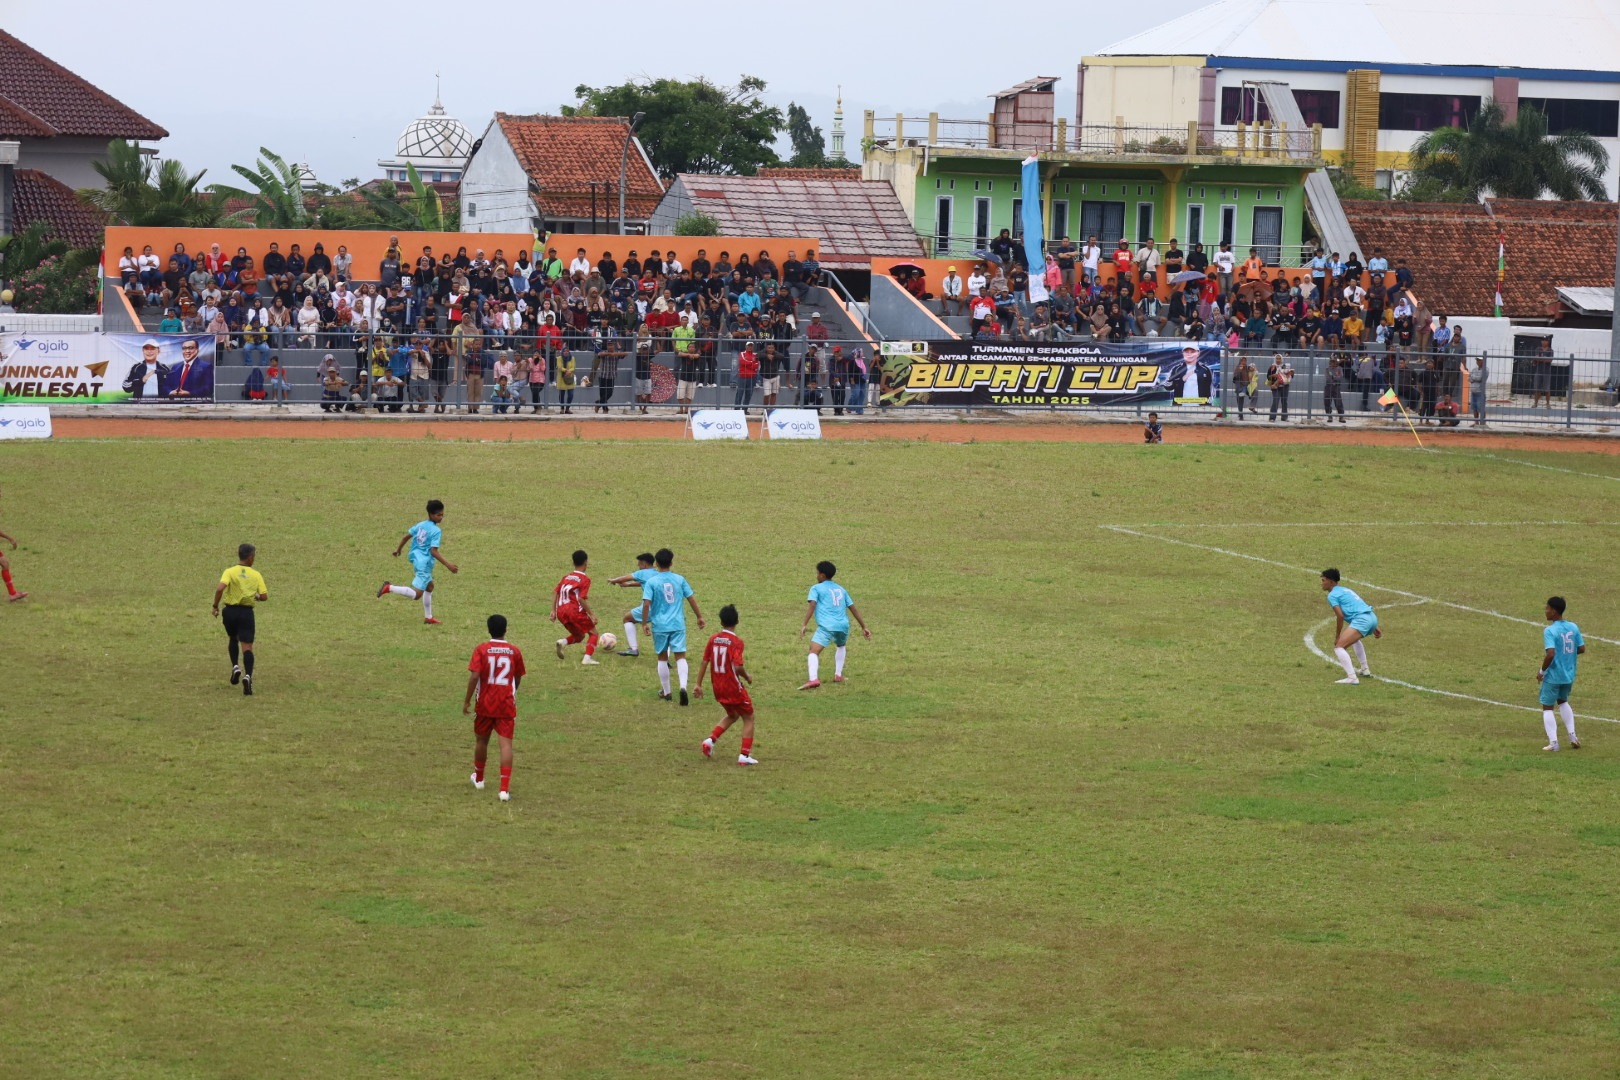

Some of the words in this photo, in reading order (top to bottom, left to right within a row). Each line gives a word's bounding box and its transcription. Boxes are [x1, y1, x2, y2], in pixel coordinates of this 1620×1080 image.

[38, 339, 69, 354] ajaib
[972, 345, 1034, 354] TURNAMEN
[1037, 346, 1102, 354] SEPAKBOLA
[970, 354, 1025, 362] KECAMATAN
[1027, 355, 1097, 363] SE-KABUPATEN
[904, 363, 1064, 392] BUPATI
[1067, 364, 1161, 393] CUP
[3, 382, 104, 398] MELESAT
[992, 395, 1045, 404] TAHUN
[1050, 396, 1090, 404] 2025
[16, 418, 46, 430] ajaib
[715, 420, 742, 433] ajaib
[790, 420, 815, 433] ajaib
[558, 583, 574, 607] 10
[663, 582, 675, 604] 8
[1560, 631, 1575, 654] 15
[487, 655, 512, 686] 12
